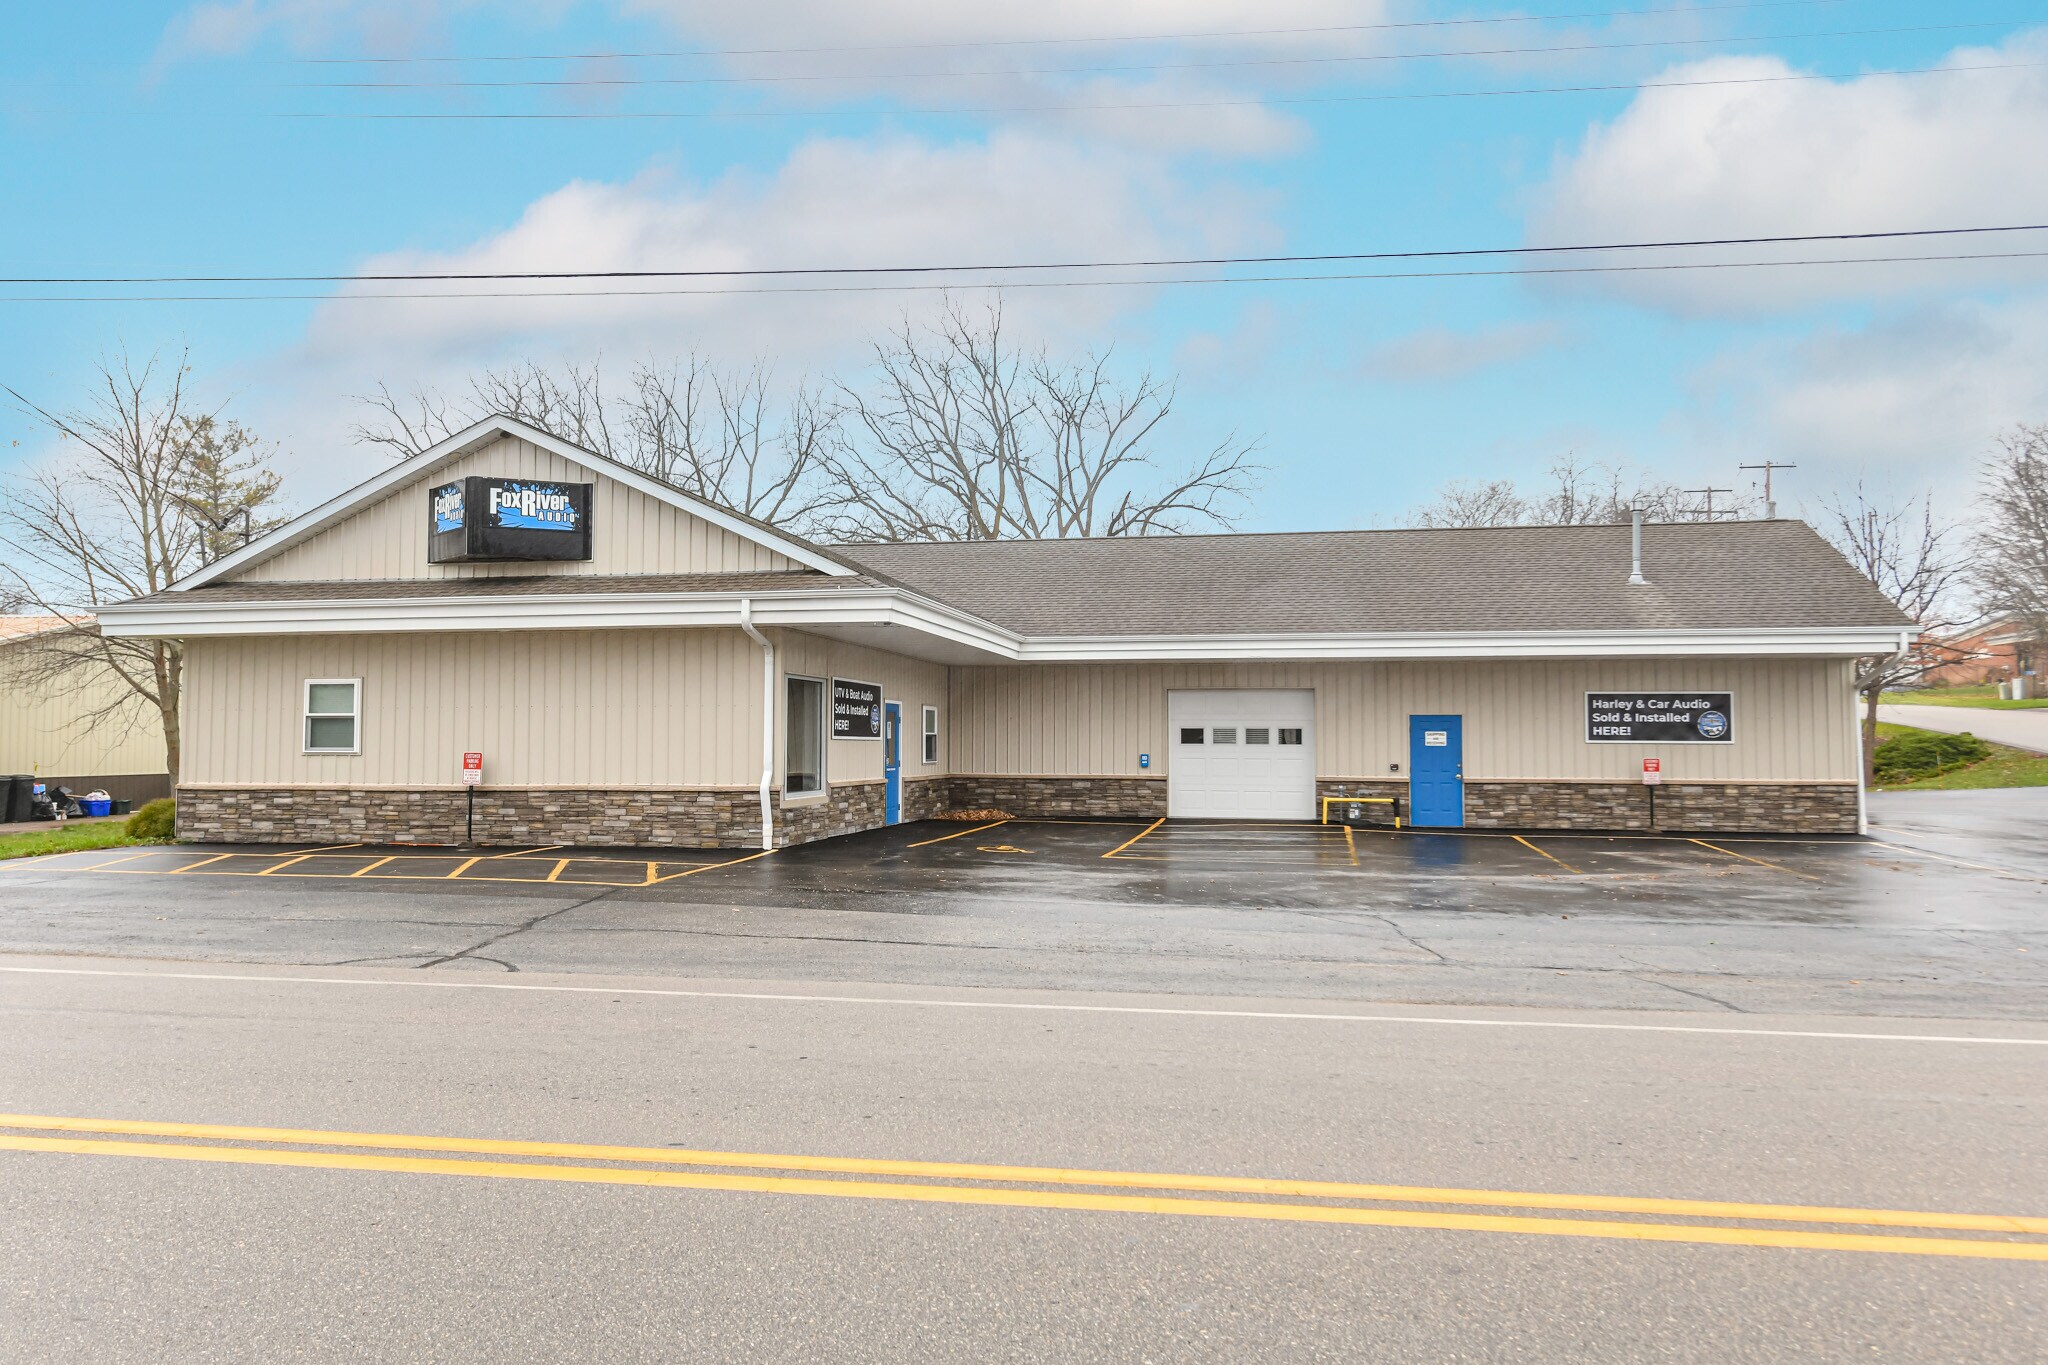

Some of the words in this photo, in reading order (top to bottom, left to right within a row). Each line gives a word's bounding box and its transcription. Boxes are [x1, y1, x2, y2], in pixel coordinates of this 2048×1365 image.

[537, 511, 576, 523] AUDIO
[834, 687, 845, 698] UTV
[845, 688, 849, 699] &
[850, 688, 860, 700] Boat
[861, 690, 873, 701] Audio
[834, 703, 846, 715] Sold
[846, 704, 850, 714] &
[850, 704, 869, 716] Installed
[1592, 699, 1633, 711] Harley
[1636, 699, 1645, 709] &
[1647, 699, 1670, 709] Car
[1672, 698, 1711, 709] Audio
[1592, 712, 1620, 723] Sold
[1622, 712, 1632, 723] &
[1635, 712, 1690, 723] Installed
[834, 720, 850, 730] HERE!
[1592, 726, 1632, 736] HERE!
